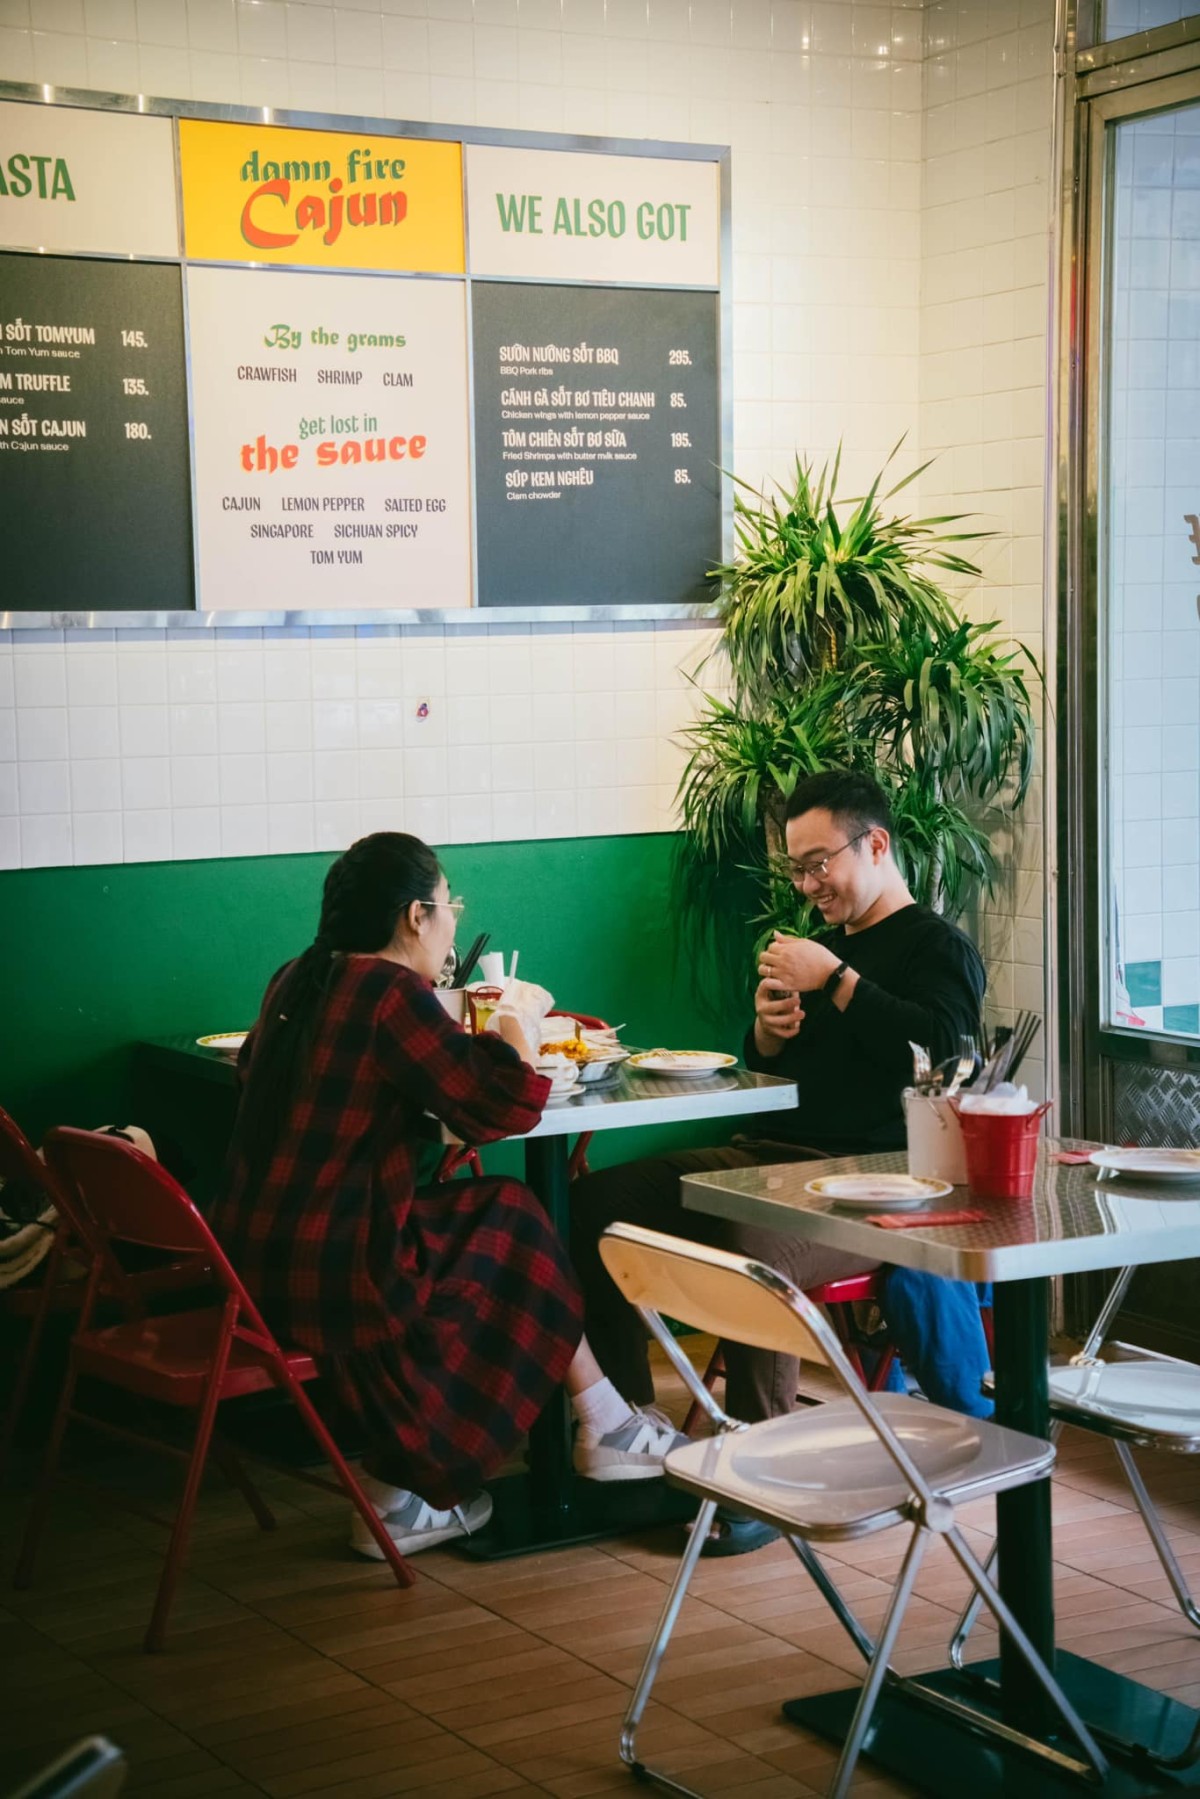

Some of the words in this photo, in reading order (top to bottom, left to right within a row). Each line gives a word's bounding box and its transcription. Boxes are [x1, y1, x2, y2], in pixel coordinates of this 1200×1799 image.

[240, 150, 331, 182] damn
[348, 148, 406, 183] fire
[240, 177, 408, 249] Cajun
[496, 193, 543, 234] WE
[553, 197, 626, 238] ALSO
[636, 202, 691, 241] GOT
[36, 325, 95, 345] TOMYUM
[121, 330, 148, 348] 145.
[264, 324, 302, 350] By
[310, 326, 339, 347] the
[347, 333, 407, 352] grams
[5, 346, 27, 355] Tom
[28, 347, 50, 357] Yum
[51, 350, 81, 358] sauce
[596, 348, 619, 365] BBQ
[669, 350, 692, 366] 295.
[237, 366, 297, 382] CRAWFISH
[317, 370, 363, 385] SHRIMP
[383, 372, 413, 387] CLAM
[500, 366, 518, 376] BBQ
[520, 367, 537, 375] Pork
[539, 367, 553, 375] ribs
[15, 373, 71, 392] TRUFFLE
[123, 378, 149, 396] 135.
[618, 392, 655, 407] CHANH
[670, 393, 687, 407] 85.
[502, 411, 533, 420] Chicken
[534, 411, 556, 421] wings
[558, 411, 574, 420] with
[575, 412, 599, 420] lemon
[600, 413, 626, 421] pepper
[42, 420, 87, 437] CAJUN
[125, 422, 152, 440] 180.
[299, 417, 326, 440] get
[331, 415, 359, 435] lost
[363, 413, 378, 432] in
[11, 440, 39, 452] Cajun
[40, 443, 69, 451] sauce
[502, 429, 526, 447] TÔM
[240, 434, 299, 474] the
[316, 434, 427, 466] sauce
[503, 452, 522, 460] Fried
[524, 452, 556, 461] Shrimps
[557, 452, 573, 460] with
[574, 452, 596, 460] butter
[598, 452, 613, 460] milk
[531, 471, 554, 487] KEM
[675, 470, 691, 484] 85.
[507, 491, 527, 500] Clam
[528, 491, 561, 500] chowder
[222, 497, 261, 511] CAJUN
[282, 497, 319, 512] LEMON
[323, 497, 365, 512] PEPPER
[384, 498, 422, 513] SALTED
[425, 499, 446, 513] EGG
[250, 524, 314, 538] SINGAPORE
[334, 524, 383, 538] SICHUAN
[386, 524, 418, 538] SPICY
[310, 550, 334, 565] TOM
[337, 550, 363, 564] YUM
